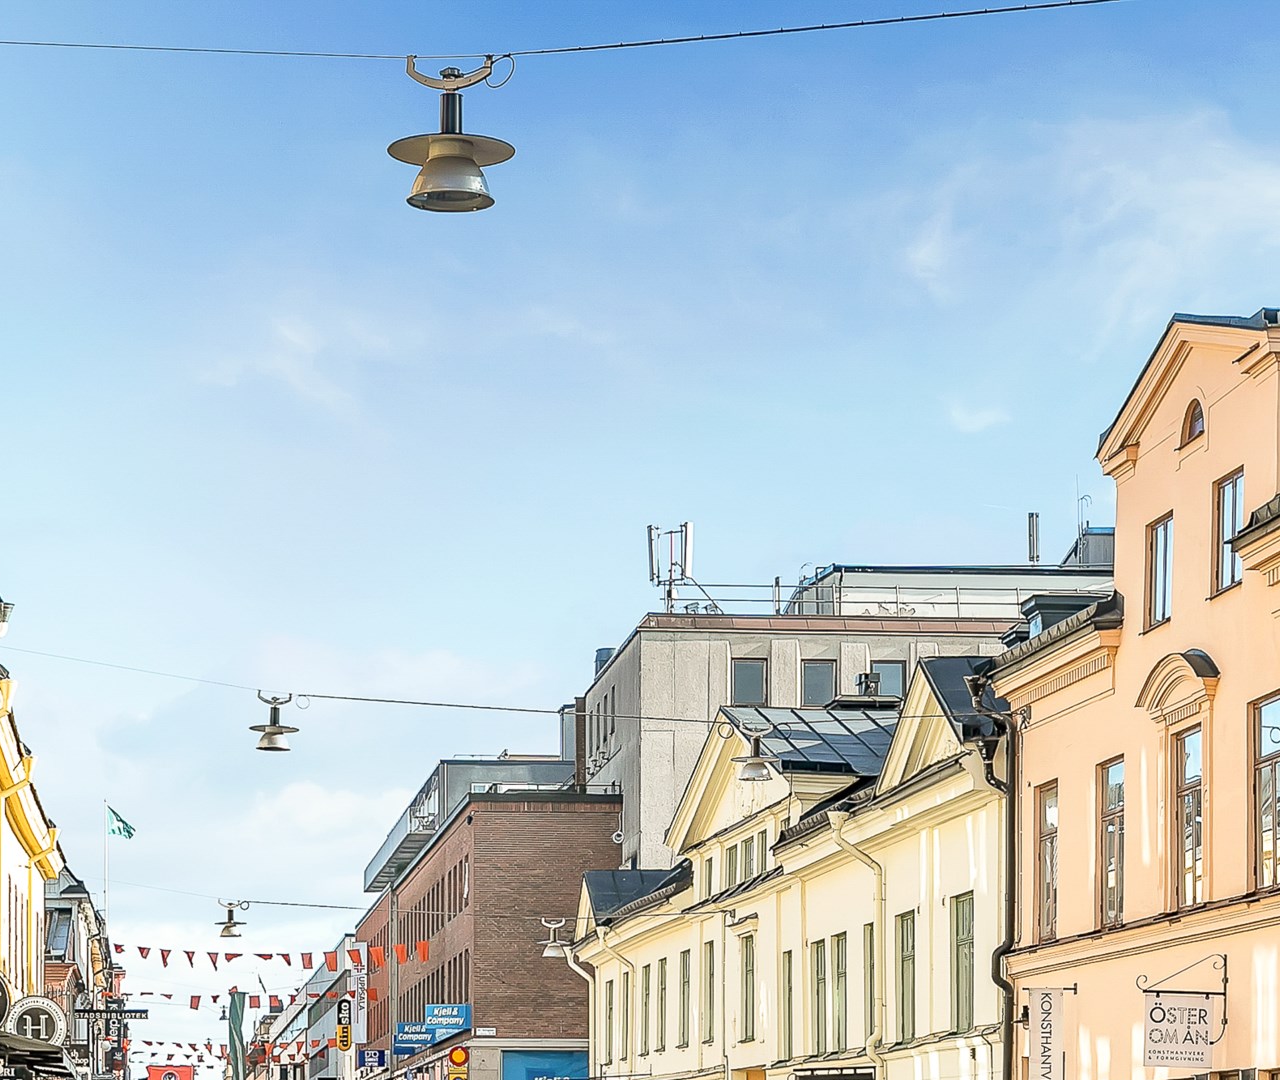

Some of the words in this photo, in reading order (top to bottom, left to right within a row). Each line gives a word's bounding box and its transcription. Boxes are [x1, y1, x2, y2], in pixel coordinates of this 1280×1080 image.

[433, 1007, 451, 1016] Kjell
[452, 1007, 459, 1015] &
[1150, 1002, 1208, 1024] ÖSTER
[427, 1017, 464, 1025] Company
[398, 1033, 432, 1042] Company
[1149, 1028, 1178, 1044] OM
[1182, 1025, 1209, 1045] ÅN
